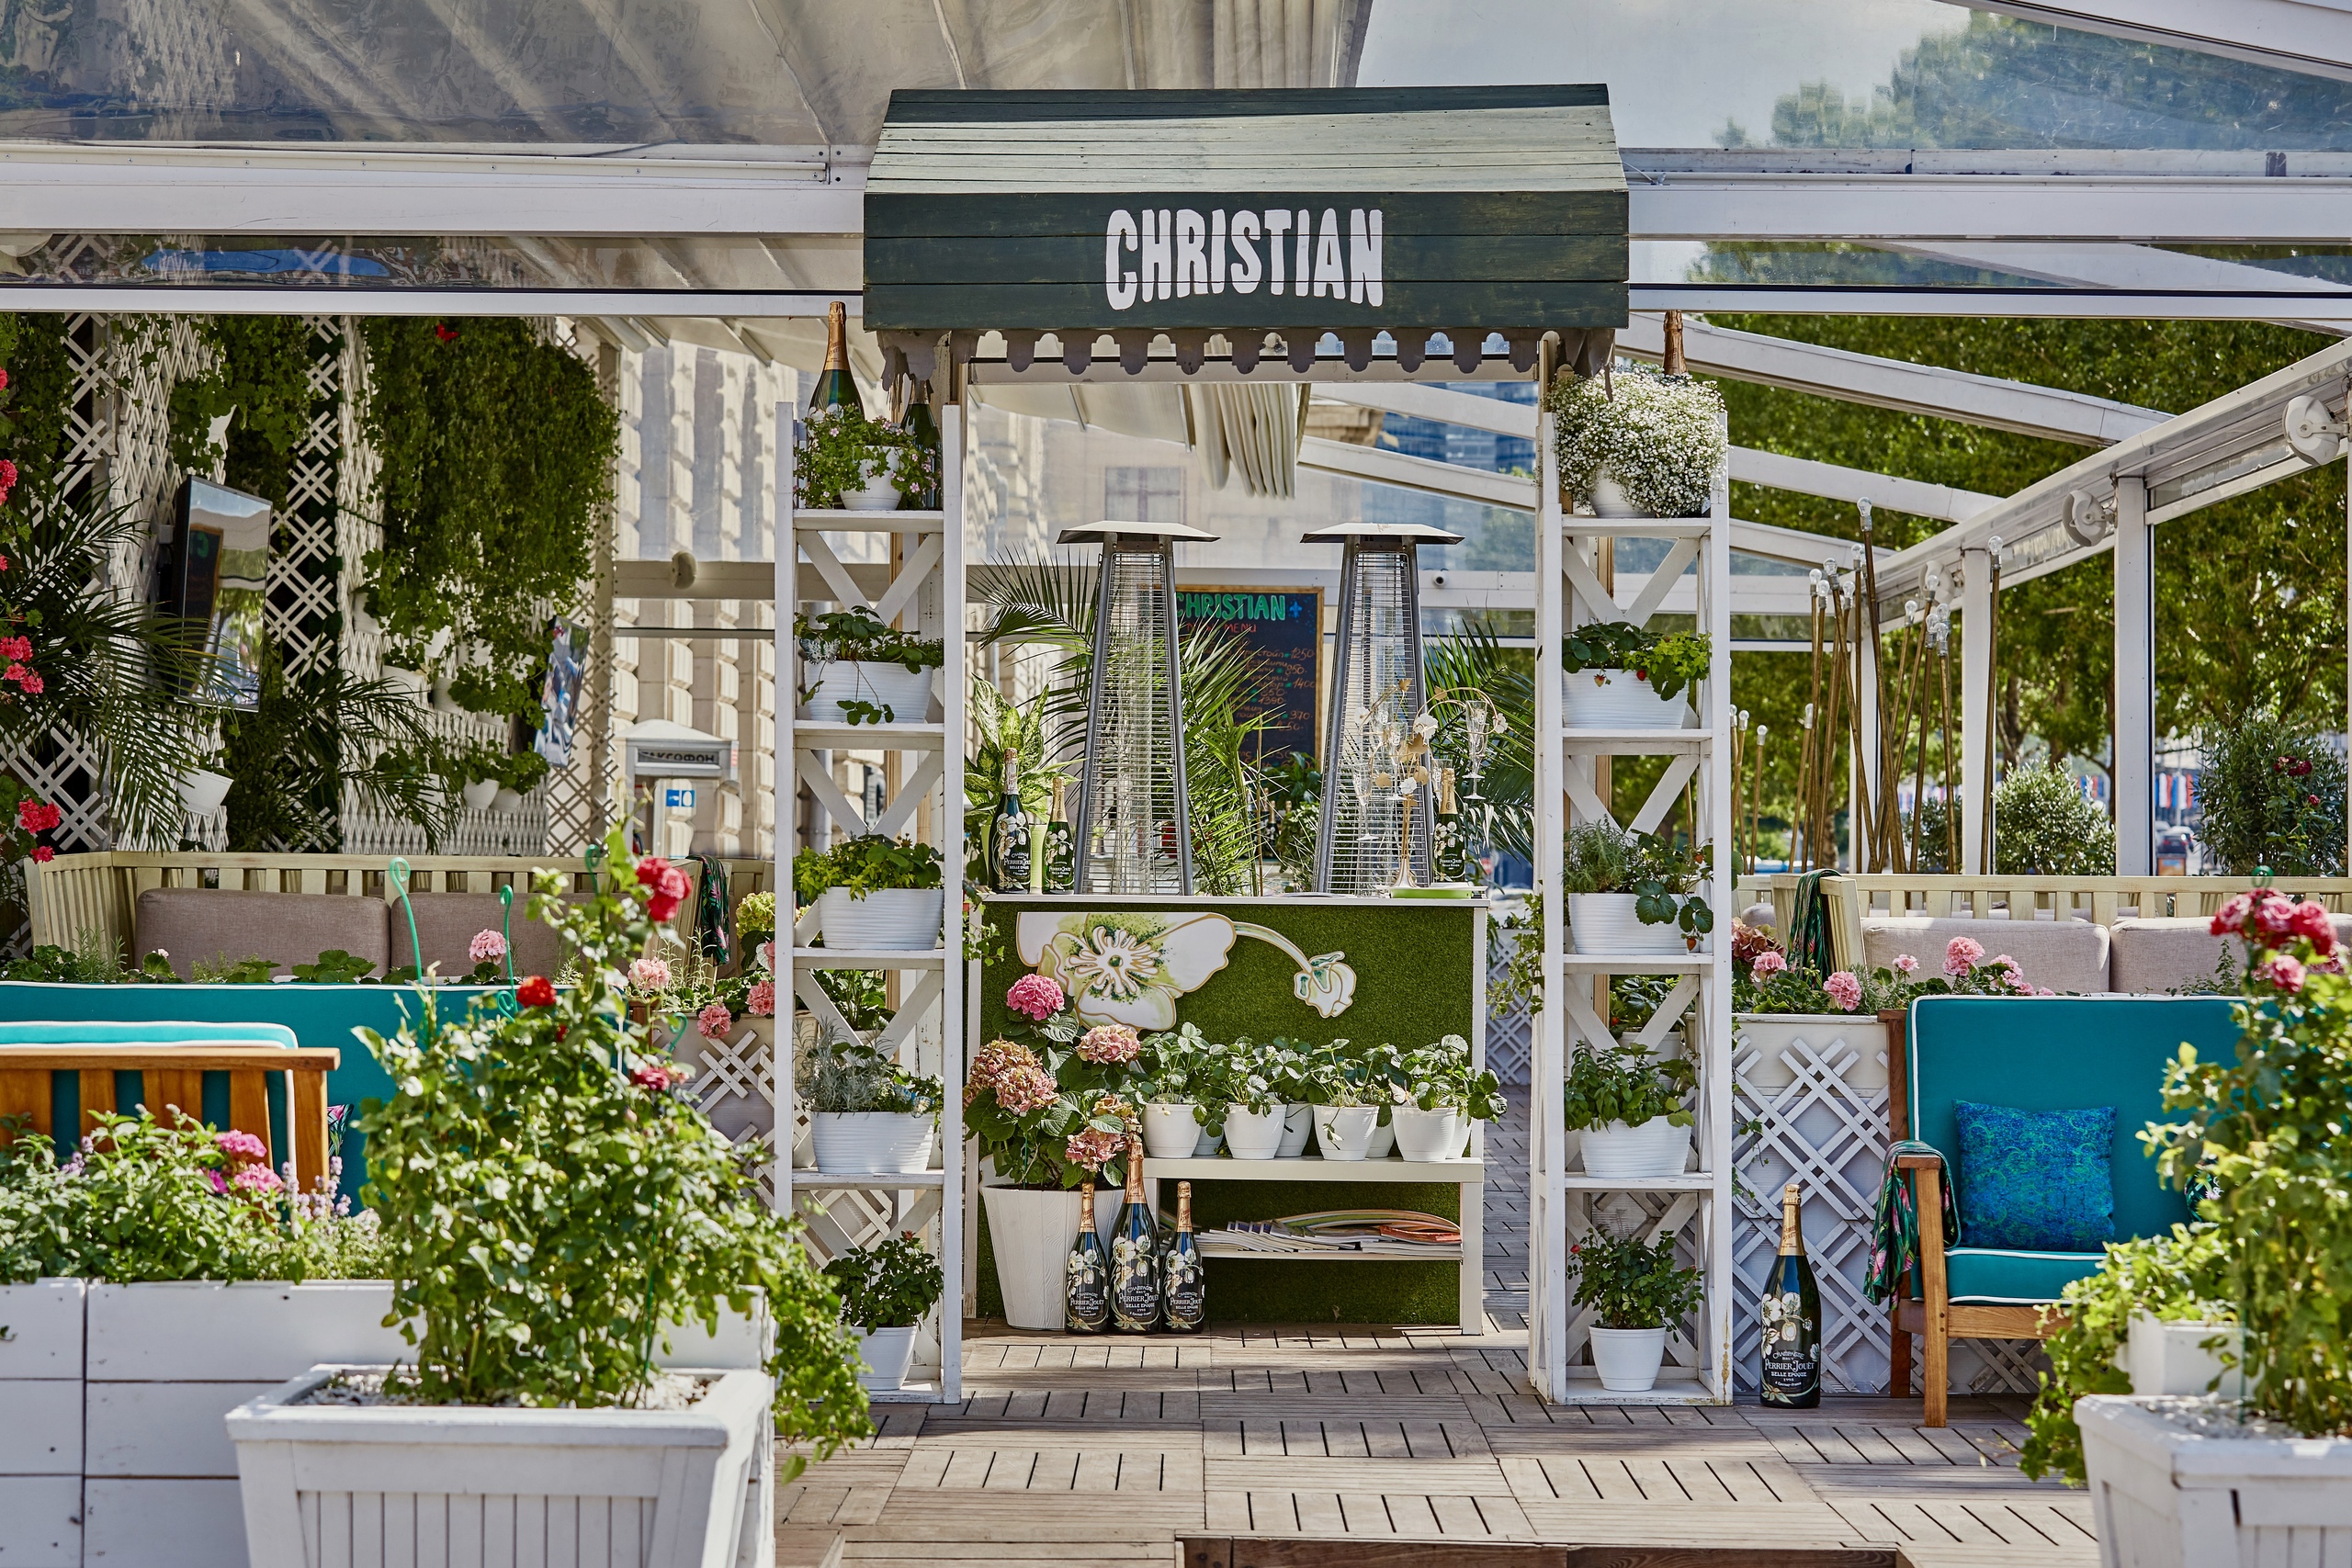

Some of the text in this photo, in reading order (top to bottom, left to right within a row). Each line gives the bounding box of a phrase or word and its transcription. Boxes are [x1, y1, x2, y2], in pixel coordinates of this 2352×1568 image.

[1105, 208, 1383, 310] CHRISTIAN
[1176, 592, 1285, 621] CHRISTIAN
[1224, 622, 1257, 633] MENU
